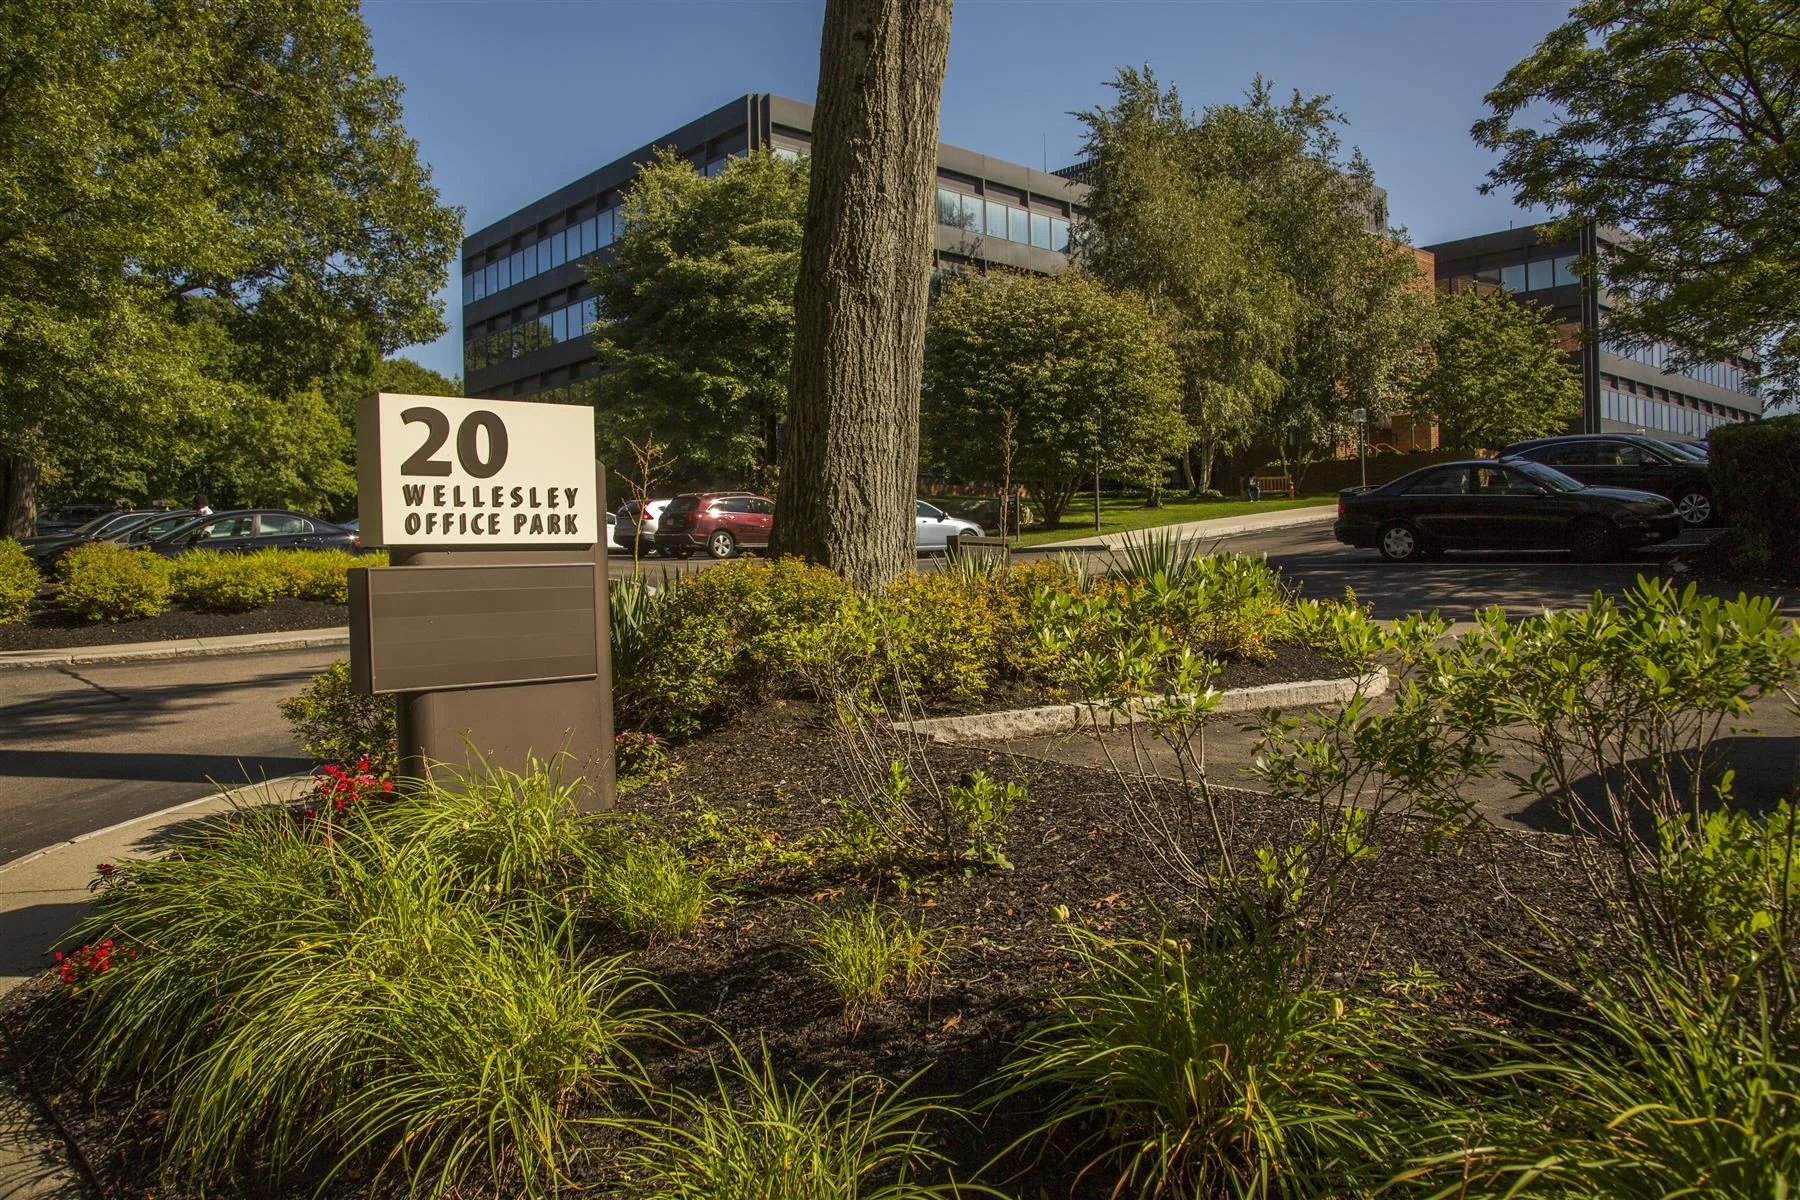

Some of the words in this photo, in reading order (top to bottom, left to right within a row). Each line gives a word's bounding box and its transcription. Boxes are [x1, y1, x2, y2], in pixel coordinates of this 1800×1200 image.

[400, 407, 508, 478] 20
[402, 484, 579, 509] WELLESLEY
[404, 513, 501, 535] OFFICE
[514, 514, 579, 535] PARK
